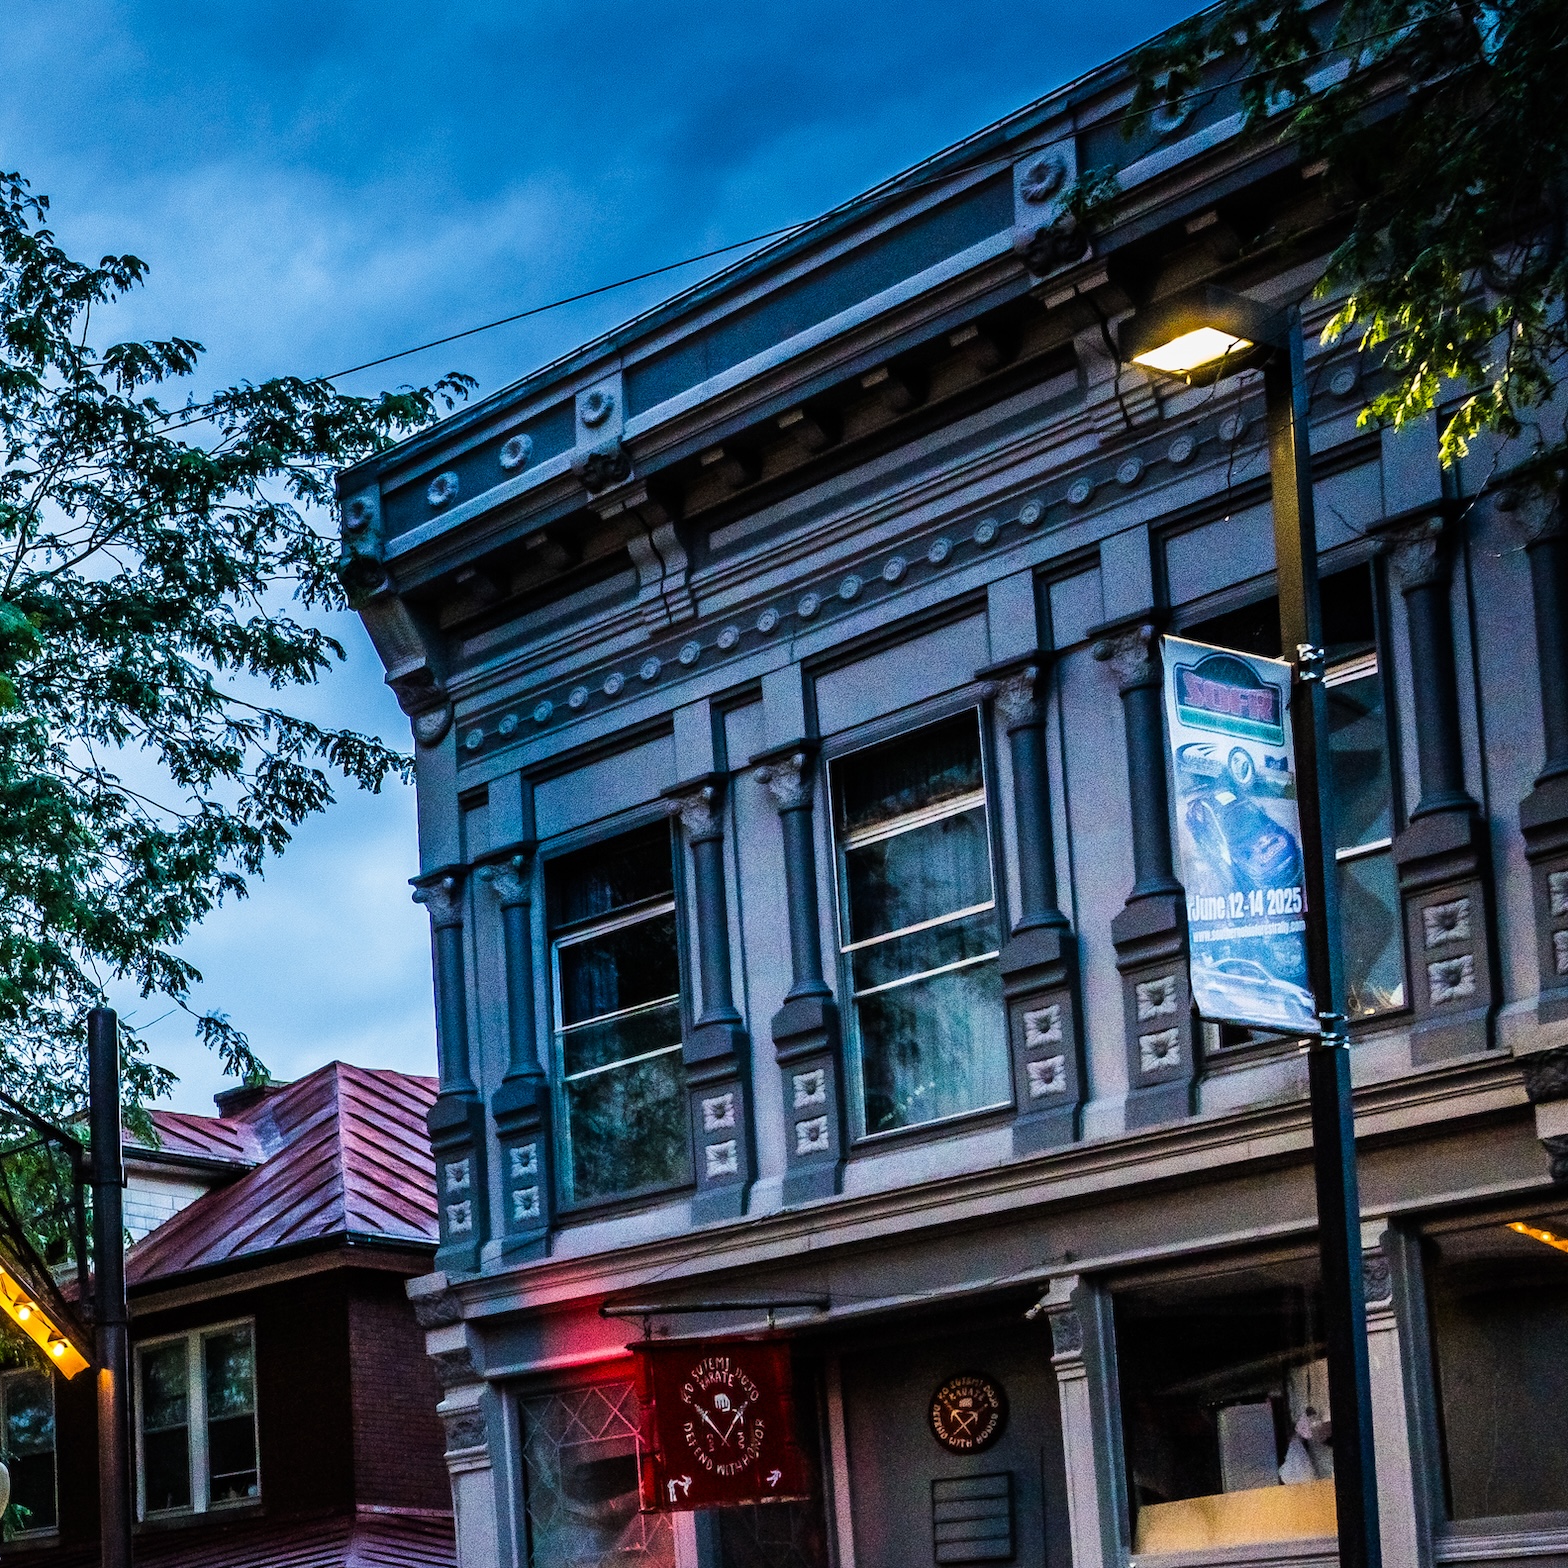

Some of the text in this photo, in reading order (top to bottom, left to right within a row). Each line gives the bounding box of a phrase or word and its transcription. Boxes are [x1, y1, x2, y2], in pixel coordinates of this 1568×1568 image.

[1228, 891, 1264, 919] 12-14
[1266, 886, 1303, 916] 2025
[684, 1421, 713, 1471] DEFEND
[949, 1436, 973, 1449] WITH
